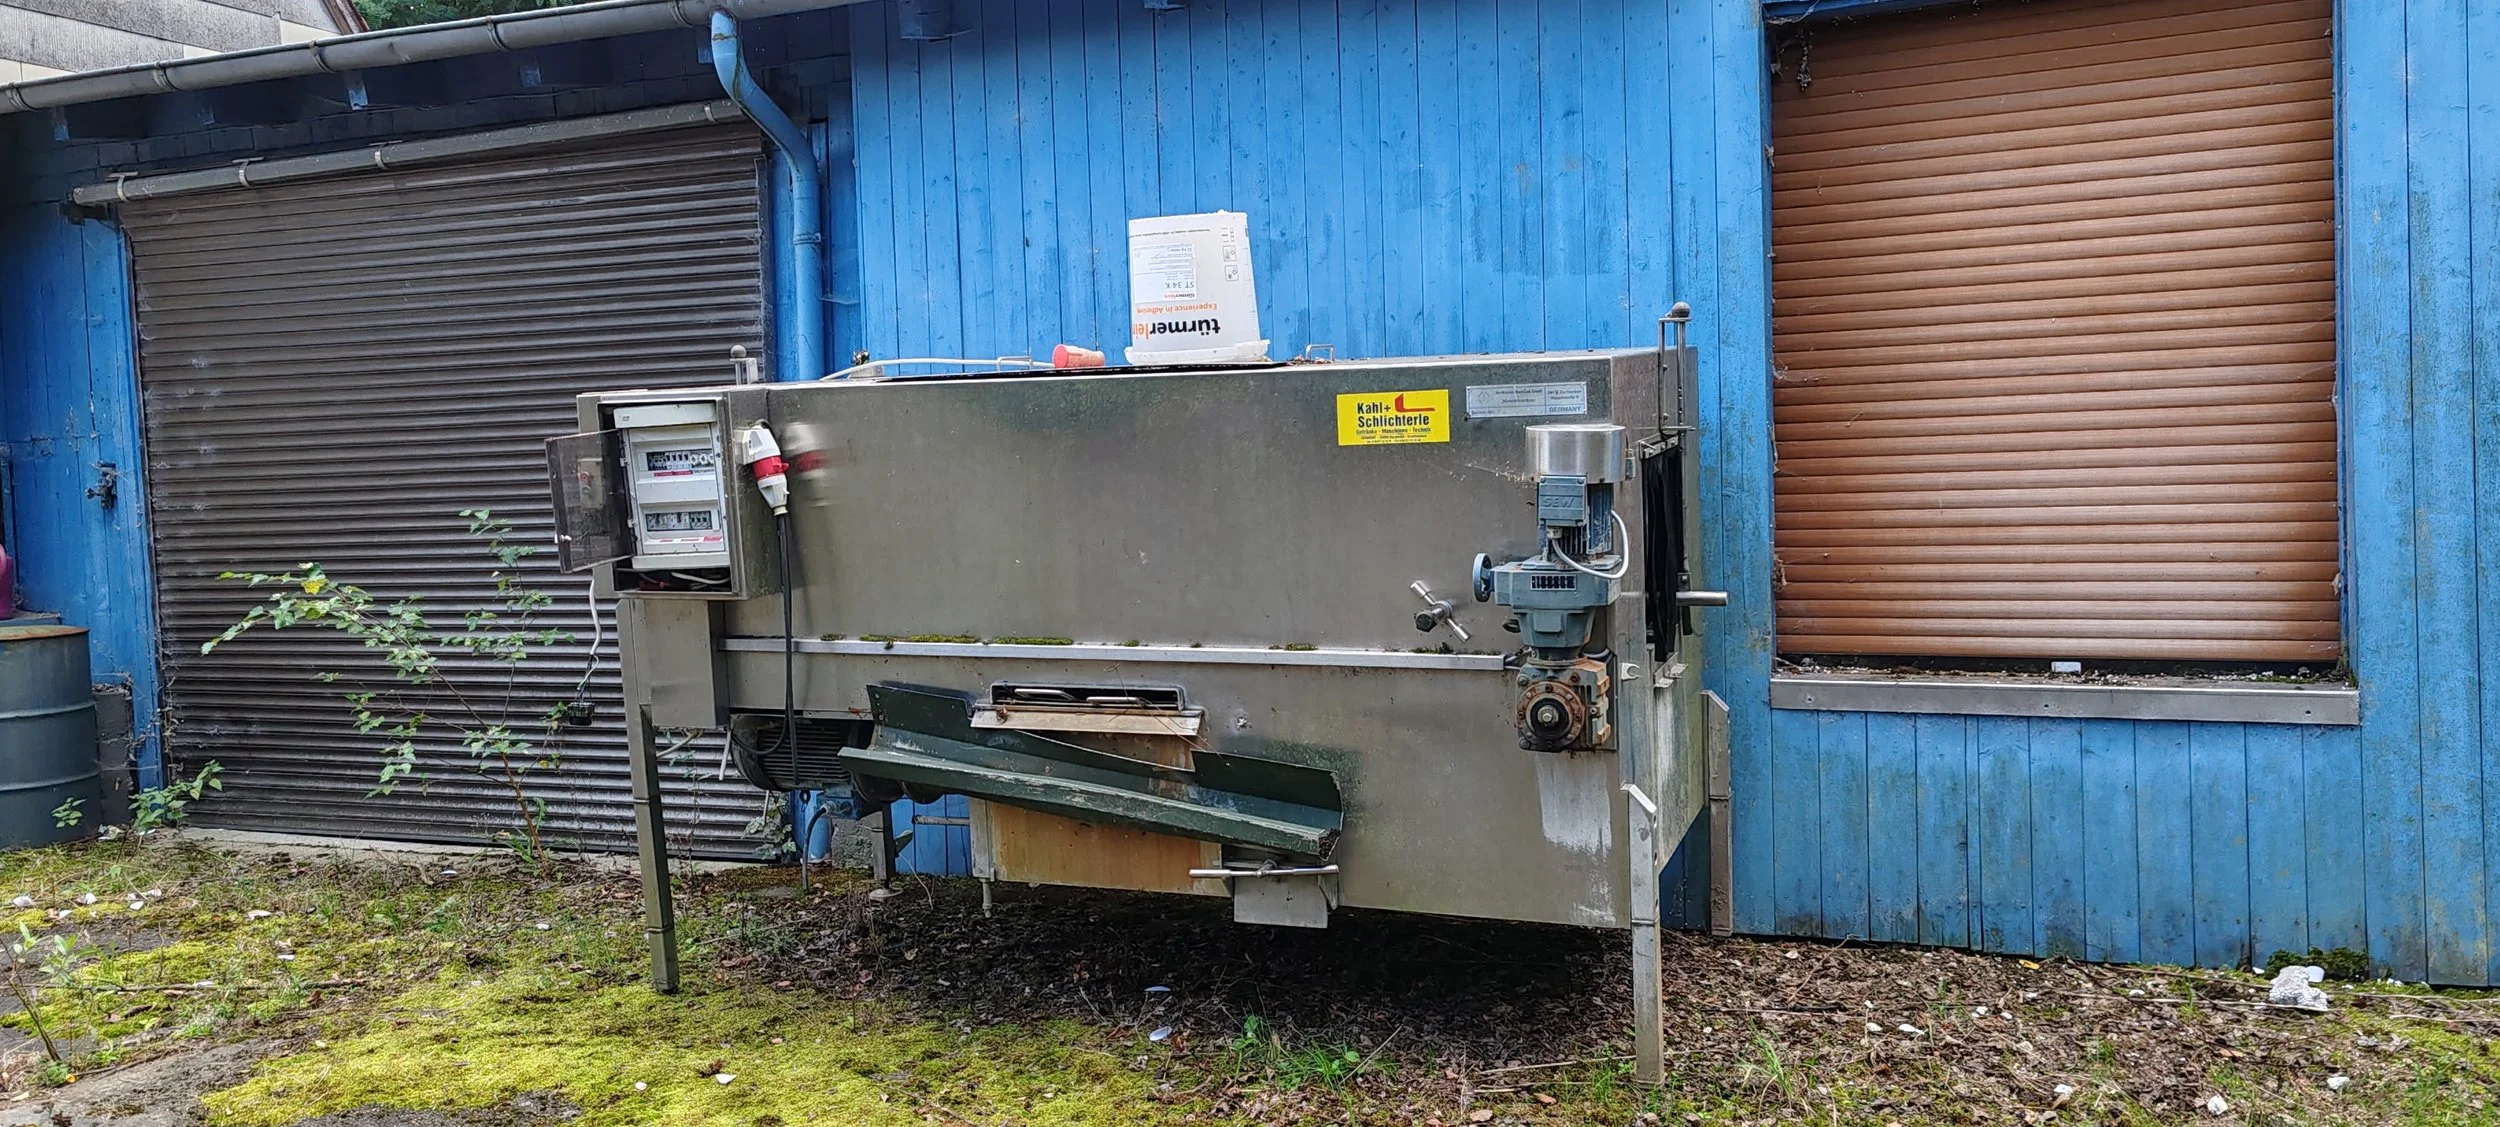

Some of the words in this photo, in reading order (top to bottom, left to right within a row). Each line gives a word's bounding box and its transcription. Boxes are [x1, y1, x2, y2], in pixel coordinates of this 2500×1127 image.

[1185, 281, 1195, 289] ST
[1165, 304, 1174, 312] in
[1174, 303, 1217, 312] Experience
[1358, 414, 1430, 428] Schlichterle
[1543, 497, 1574, 508] SEW
